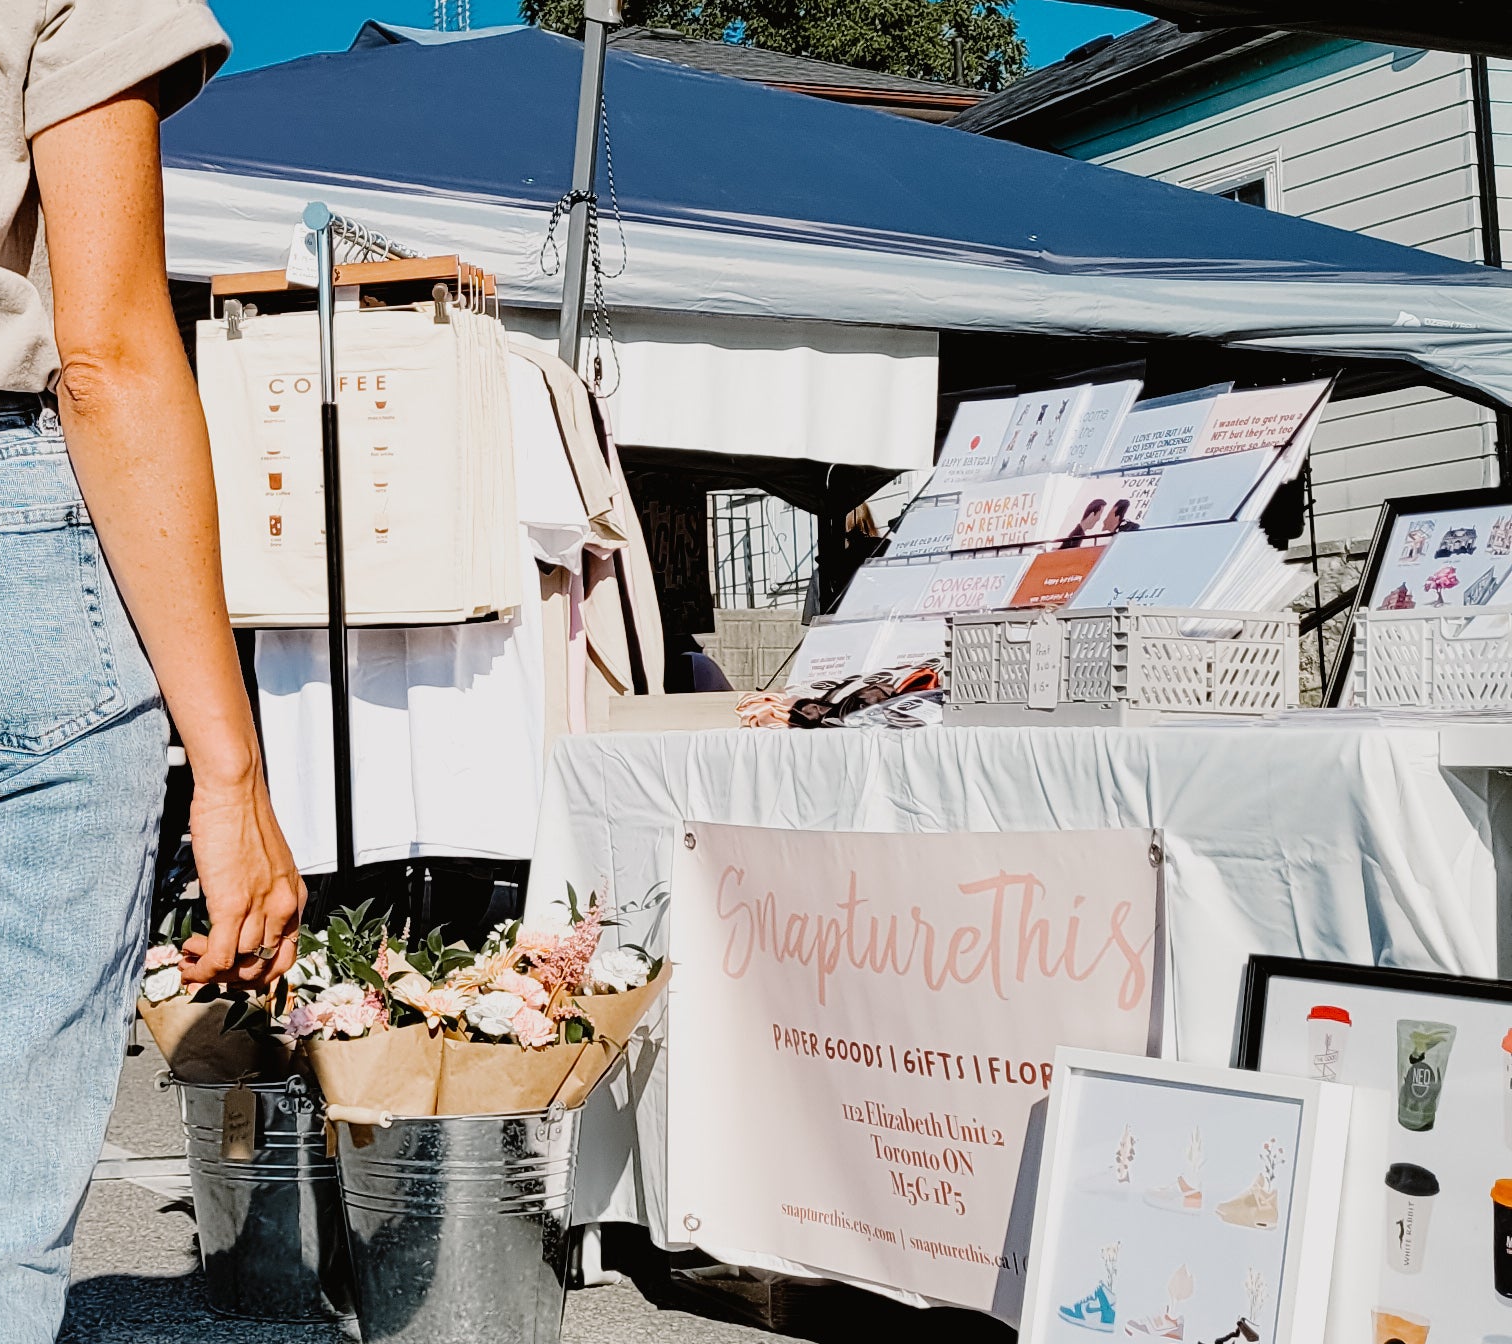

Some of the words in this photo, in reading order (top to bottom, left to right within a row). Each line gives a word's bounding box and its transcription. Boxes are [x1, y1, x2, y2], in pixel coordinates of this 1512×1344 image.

[268, 375, 387, 395] COFEE
[1210, 430, 1228, 441] NFT
[1228, 428, 1244, 439] but
[1245, 426, 1279, 439] they're
[1280, 425, 1294, 434] too
[1218, 416, 1250, 428] wanted
[1251, 416, 1260, 425] to
[1262, 415, 1277, 426] get
[1279, 413, 1296, 424] you
[966, 492, 1037, 518] CONGRATS
[957, 518, 976, 535] ON
[960, 535, 995, 549] FROM
[931, 575, 1005, 593] CONGRATS
[923, 594, 943, 609] ON
[947, 592, 985, 607] YOUR
[717, 865, 1158, 1011] SnaptureThis
[772, 1023, 820, 1057] PAPER
[824, 1037, 883, 1069] GOODS
[1412, 1067, 1431, 1086] NEO
[842, 1103, 865, 1124] 112
[864, 1100, 944, 1139] Elizabeth
[944, 1114, 989, 1145] Unit
[991, 1129, 1005, 1146] 2
[870, 1133, 940, 1171] Toronto
[943, 1147, 975, 1176] ON
[888, 1169, 930, 1206] M5G
[933, 1180, 966, 1216] 1P5
[1405, 1200, 1415, 1237] RABBIT
[781, 1202, 897, 1244] snapturethis.etsy.com
[909, 1237, 1010, 1270] snapturethis.ca
[1404, 1239, 1412, 1266] WHITE
